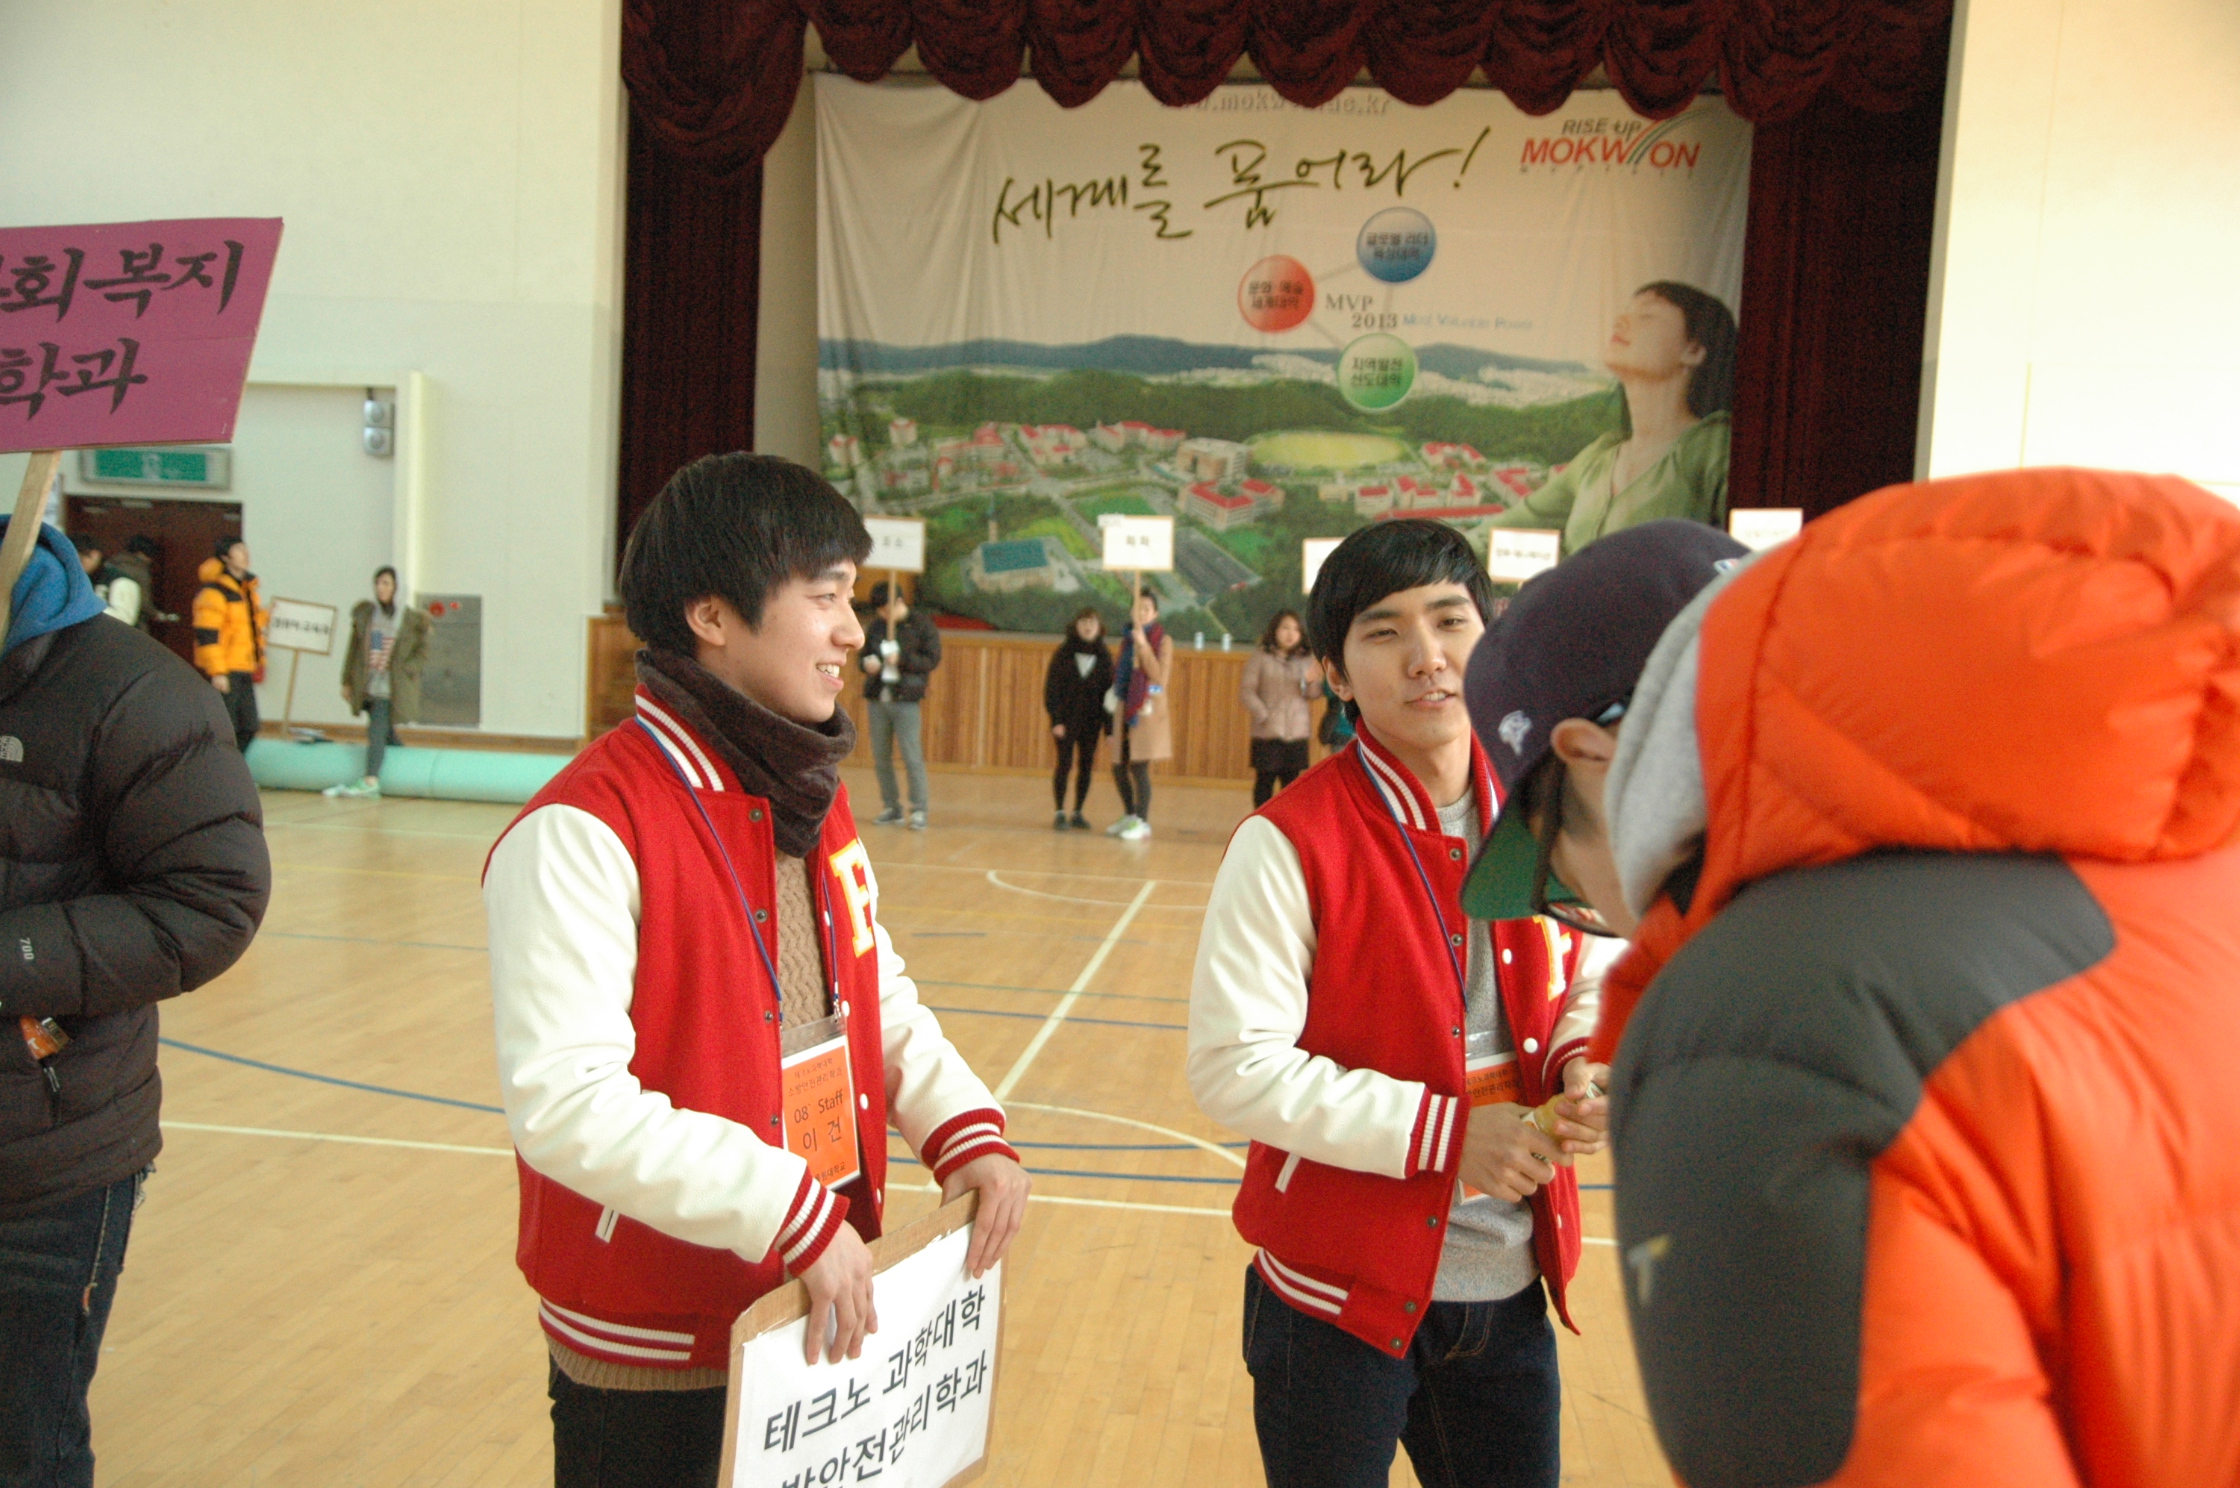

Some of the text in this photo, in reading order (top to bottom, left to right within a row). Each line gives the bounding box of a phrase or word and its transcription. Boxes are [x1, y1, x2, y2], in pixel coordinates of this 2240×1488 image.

[1562, 118, 1642, 143] RISE UP
[1520, 137, 1701, 169] MOKWON
[994, 143, 1193, 244] 세계를
[0, 239, 245, 323] 회복지
[1325, 294, 1374, 312] MVP
[1352, 312, 1398, 329] 2013
[0, 337, 148, 421] 학과
[20, 937, 35, 961] 700
[818, 1088, 843, 1114] Staff
[803, 1116, 842, 1152] 이 건
[764, 1284, 986, 1453] 테크노 과학대학
